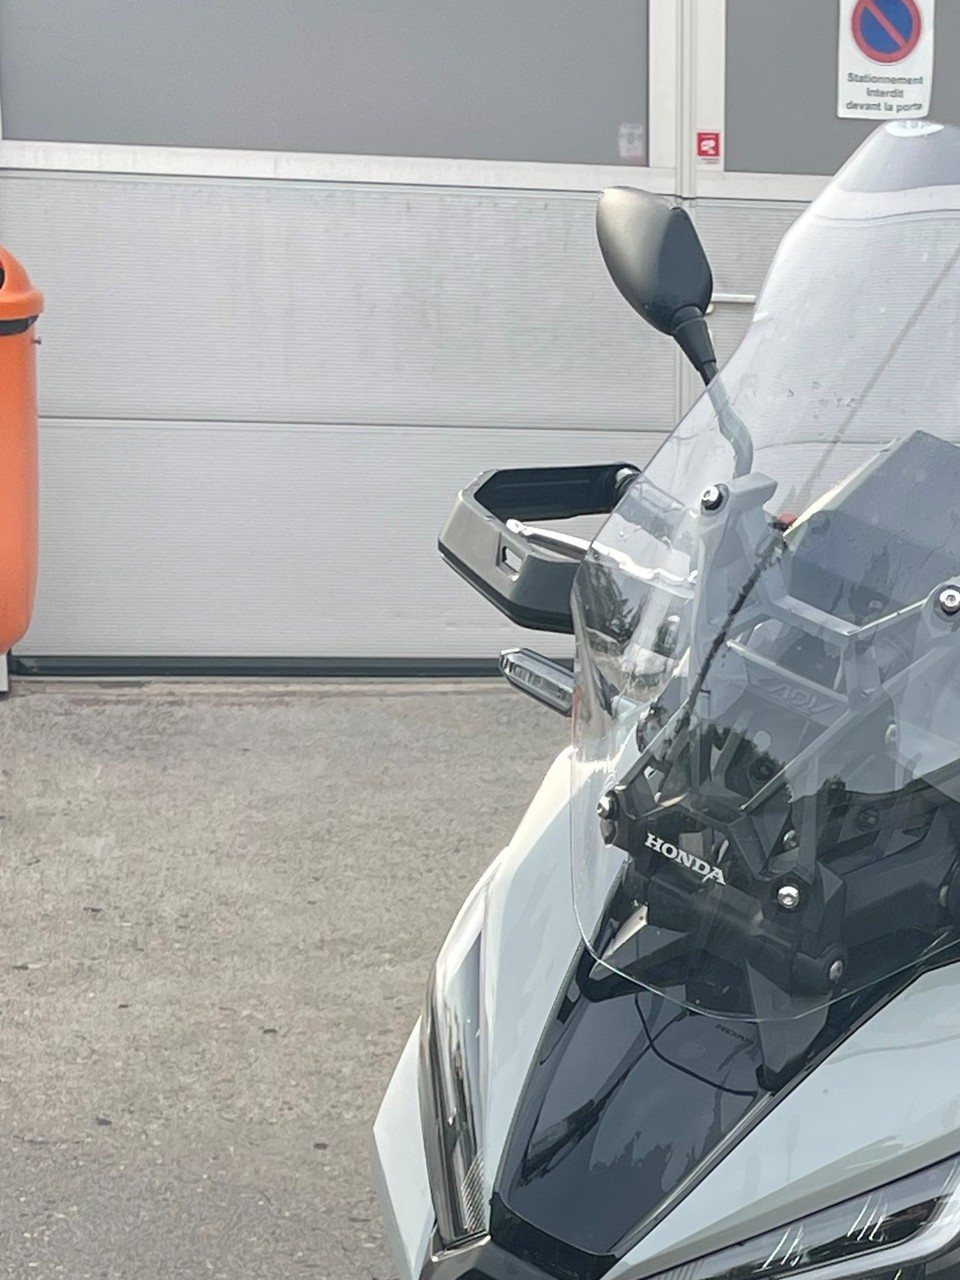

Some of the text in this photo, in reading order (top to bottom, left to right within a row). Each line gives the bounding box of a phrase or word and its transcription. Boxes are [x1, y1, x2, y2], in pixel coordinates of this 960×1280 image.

[847, 72, 924, 85] Stationnement
[845, 101, 923, 114] devant la porte
[644, 831, 727, 886] HONDA
